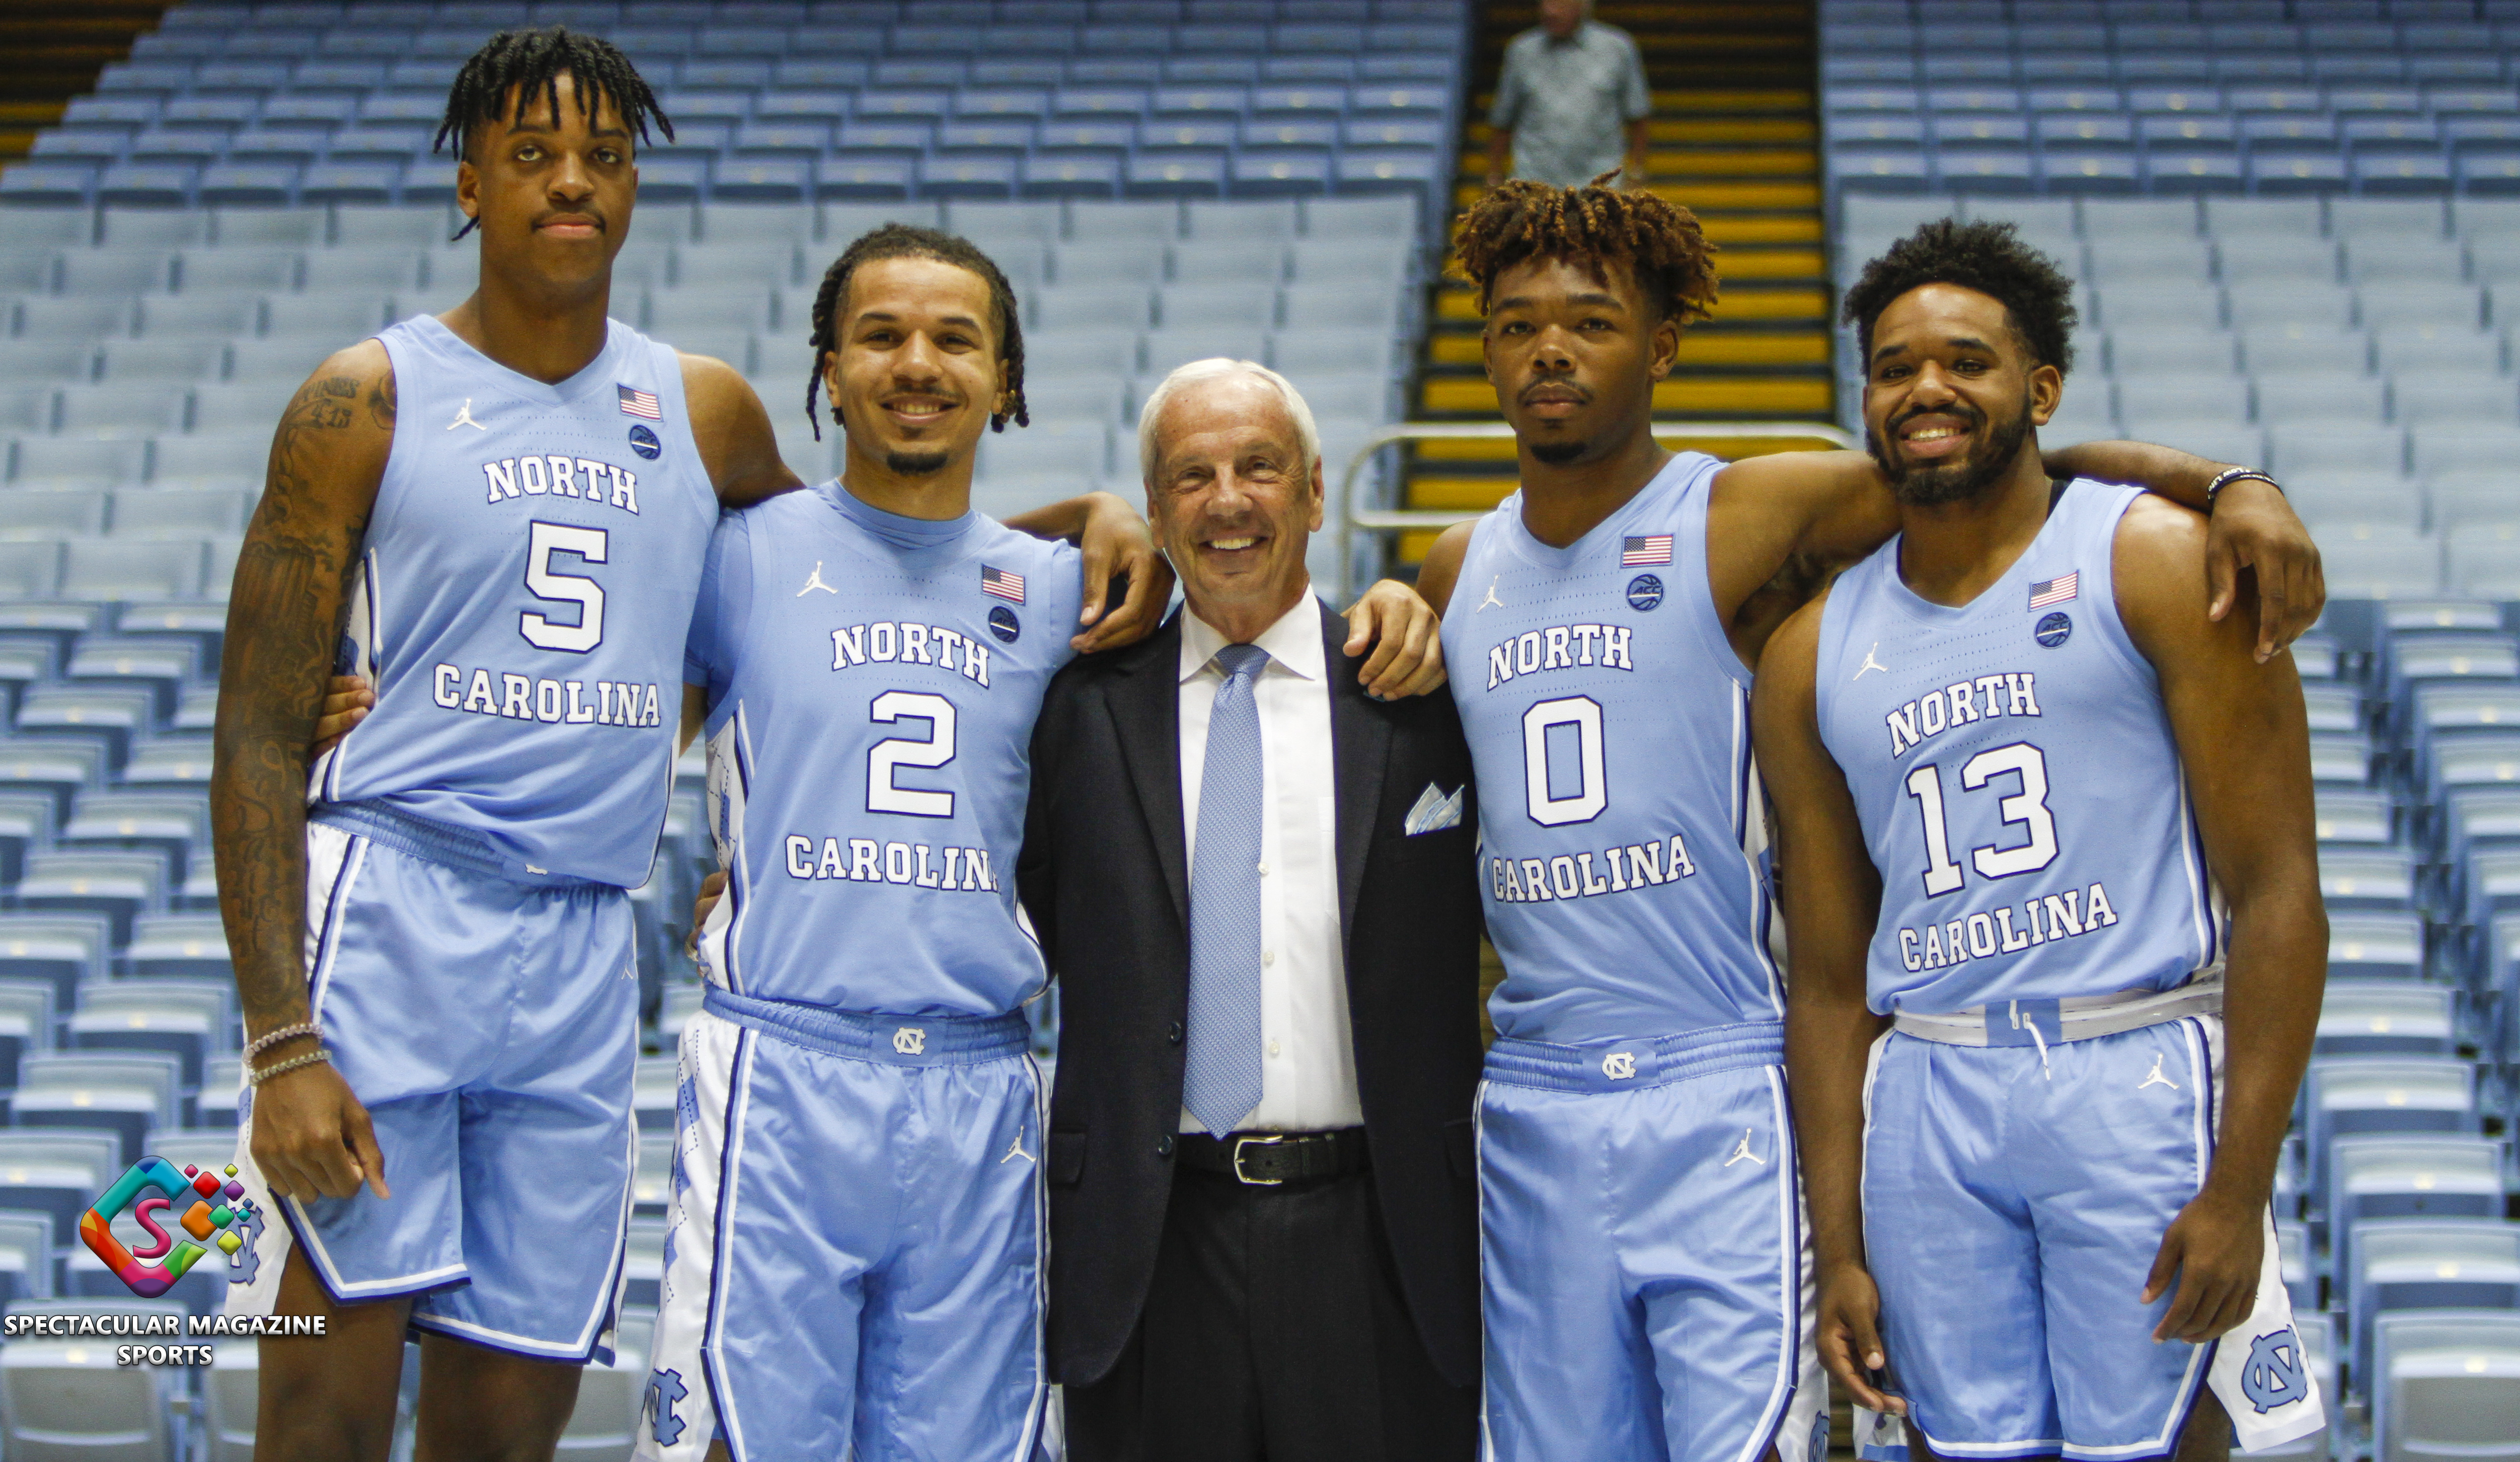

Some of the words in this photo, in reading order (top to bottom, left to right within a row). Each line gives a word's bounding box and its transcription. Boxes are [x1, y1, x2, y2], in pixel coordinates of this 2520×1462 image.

[483, 454, 639, 515] NORTH
[519, 520, 607, 654] 5
[831, 621, 989, 689] NORTH
[1487, 624, 1633, 691] NORTH
[432, 663, 660, 727] CAROLINA
[1885, 672, 2042, 759] NORTH
[866, 689, 957, 818] 2
[1521, 695, 1608, 828] 0
[1905, 741, 2059, 898] 13
[785, 834, 1001, 894] CAROLIN
[1492, 834, 1696, 903] CAROLINA
[1898, 882, 2118, 972] CAROLINA
